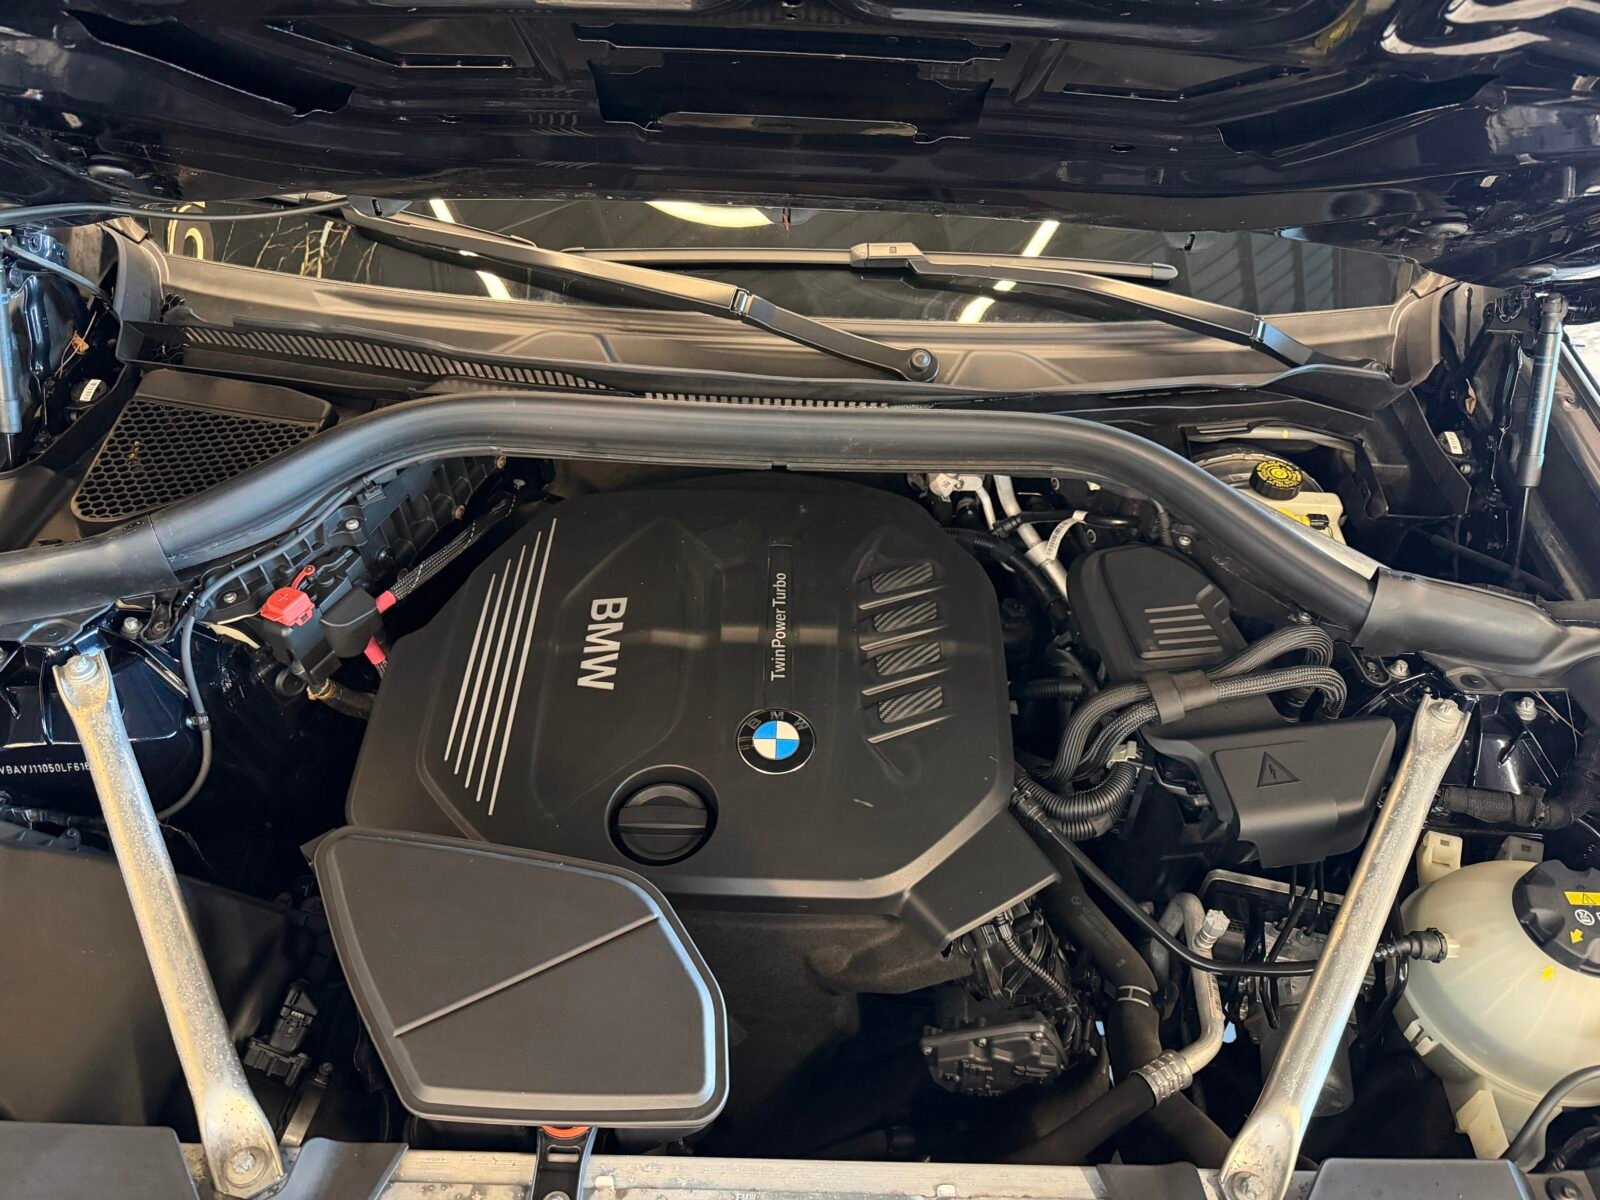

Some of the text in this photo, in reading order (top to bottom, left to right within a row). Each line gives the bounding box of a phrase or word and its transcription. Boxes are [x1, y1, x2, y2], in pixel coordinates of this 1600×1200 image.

[577, 597, 628, 690] BMW
[770, 572, 787, 681] TwinPower Turbo
[746, 711, 809, 731] BMW
